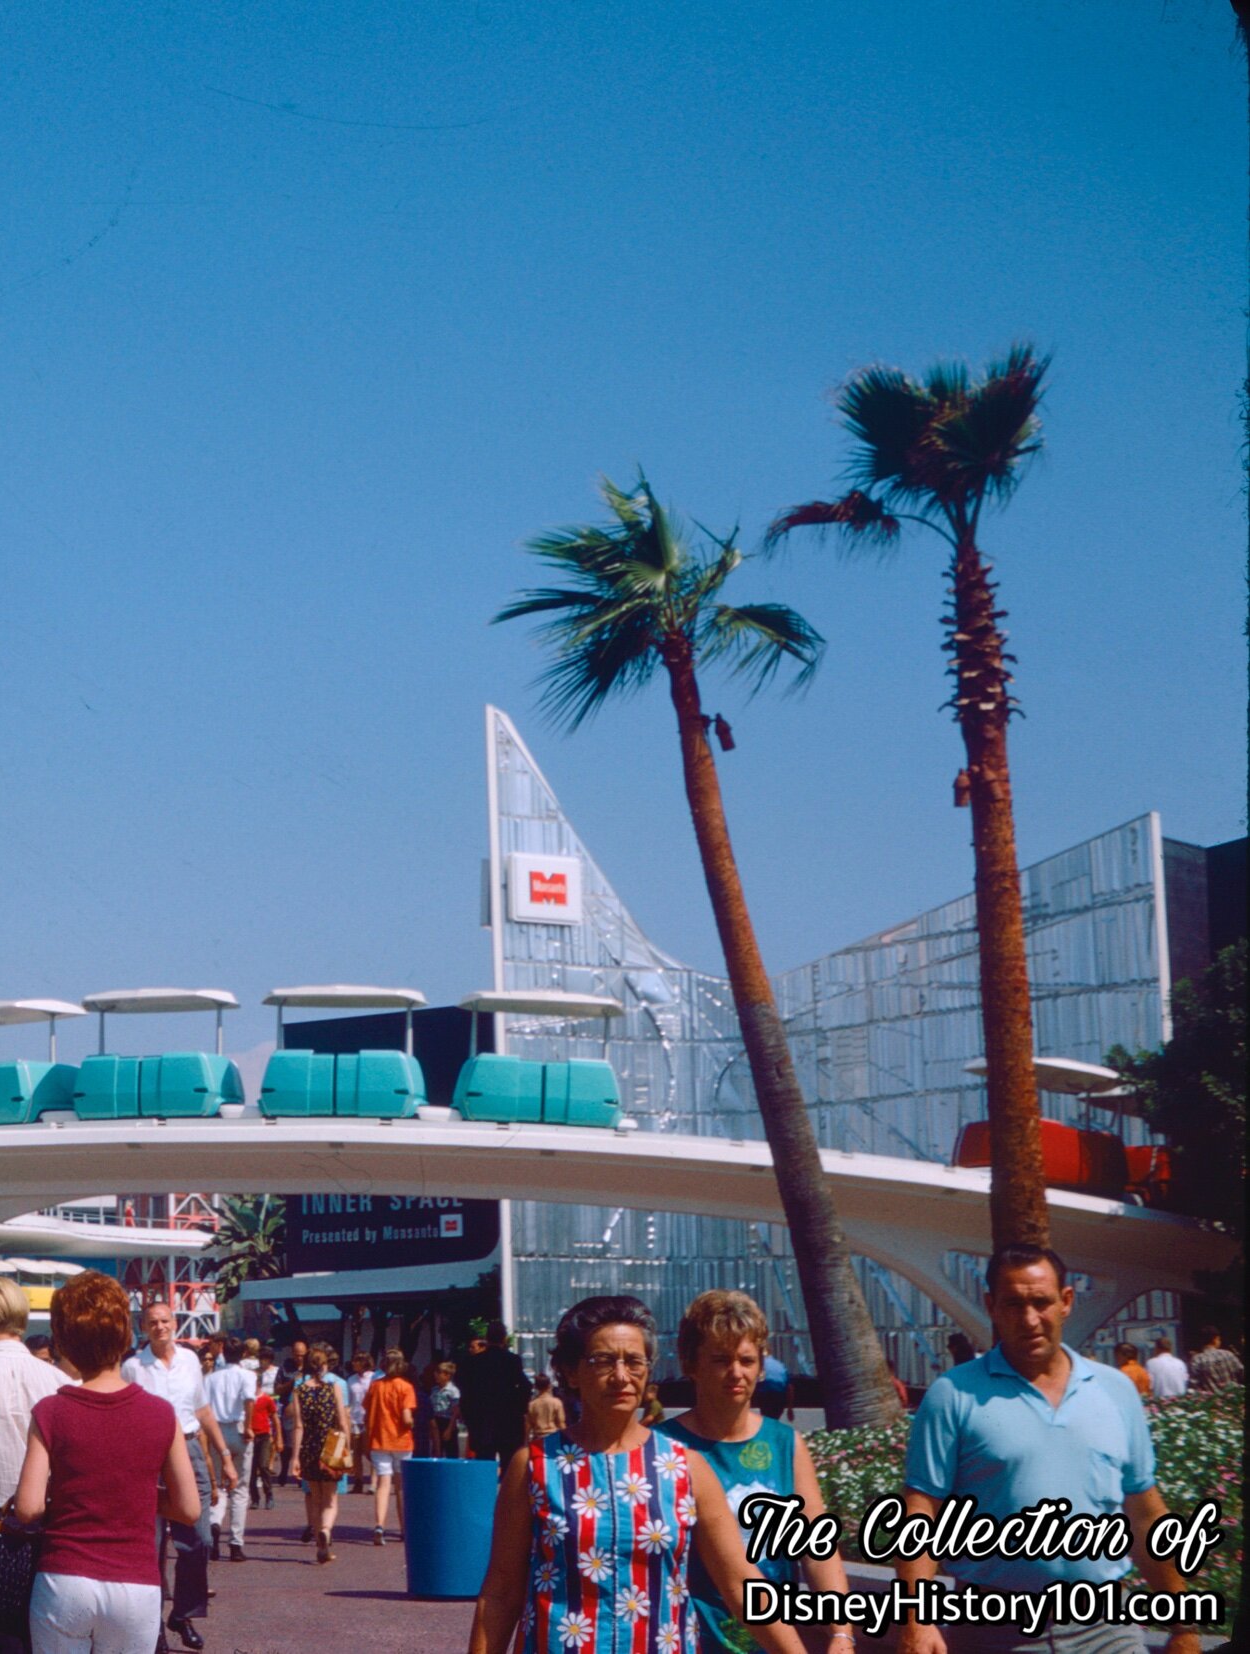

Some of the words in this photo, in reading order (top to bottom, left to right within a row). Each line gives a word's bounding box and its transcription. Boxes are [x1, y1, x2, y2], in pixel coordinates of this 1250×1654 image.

[302, 1193, 373, 1215] INNER
[302, 1227, 360, 1245] Presented
[365, 1226, 377, 1244] by
[382, 1224, 439, 1241] Monsanto
